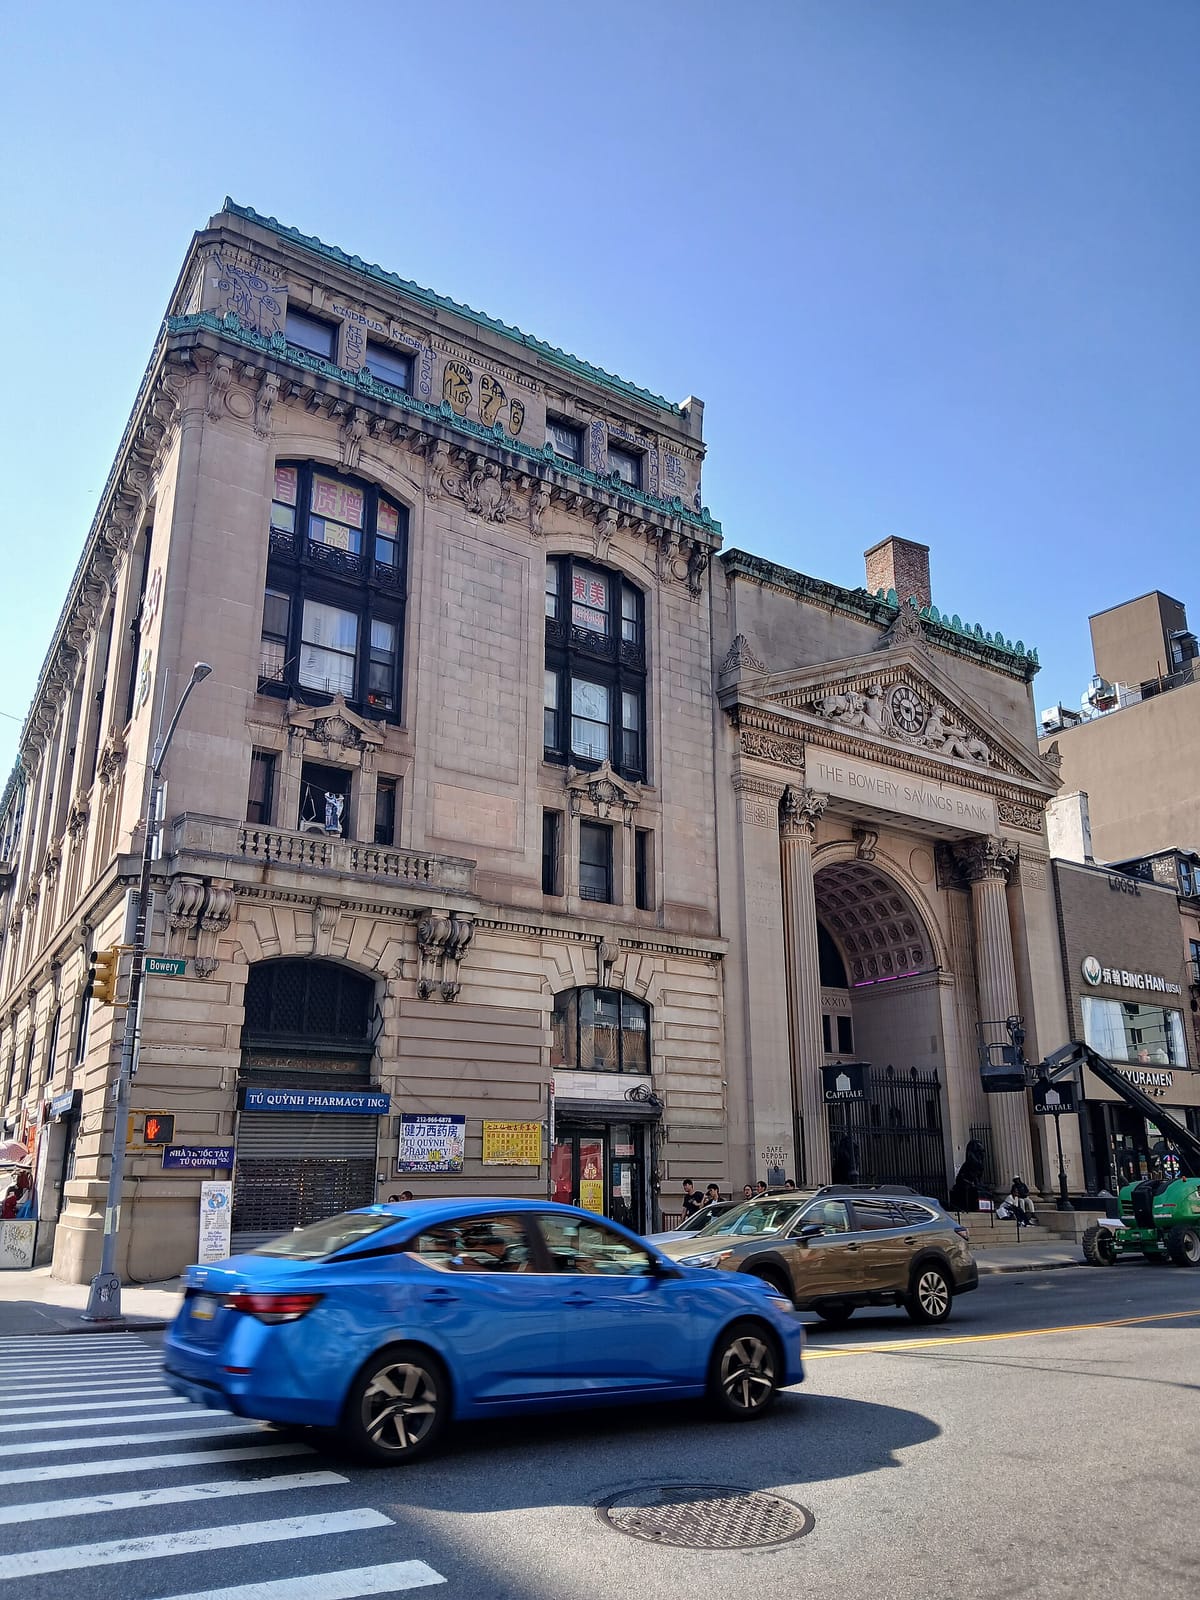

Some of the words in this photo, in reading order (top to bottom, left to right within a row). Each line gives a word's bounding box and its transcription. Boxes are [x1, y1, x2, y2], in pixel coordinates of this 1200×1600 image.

[314, 480, 363, 527] 质增
[816, 762, 843, 783] THE
[848, 771, 899, 796] BOWERY
[904, 787, 953, 811] SAVINGS
[150, 960, 179, 974] Bowery
[1121, 970, 1144, 989] BING
[1144, 974, 1166, 992] HAN
[1165, 983, 1182, 996] (USA)
[249, 1092, 264, 1104] TÚ
[266, 1093, 304, 1105] QUỲNH
[308, 1096, 365, 1107] PHARMACY
[367, 1098, 387, 1108] INC.
[404, 1124, 458, 1137] 健力西药房
[765, 1159, 785, 1167] VAULT
